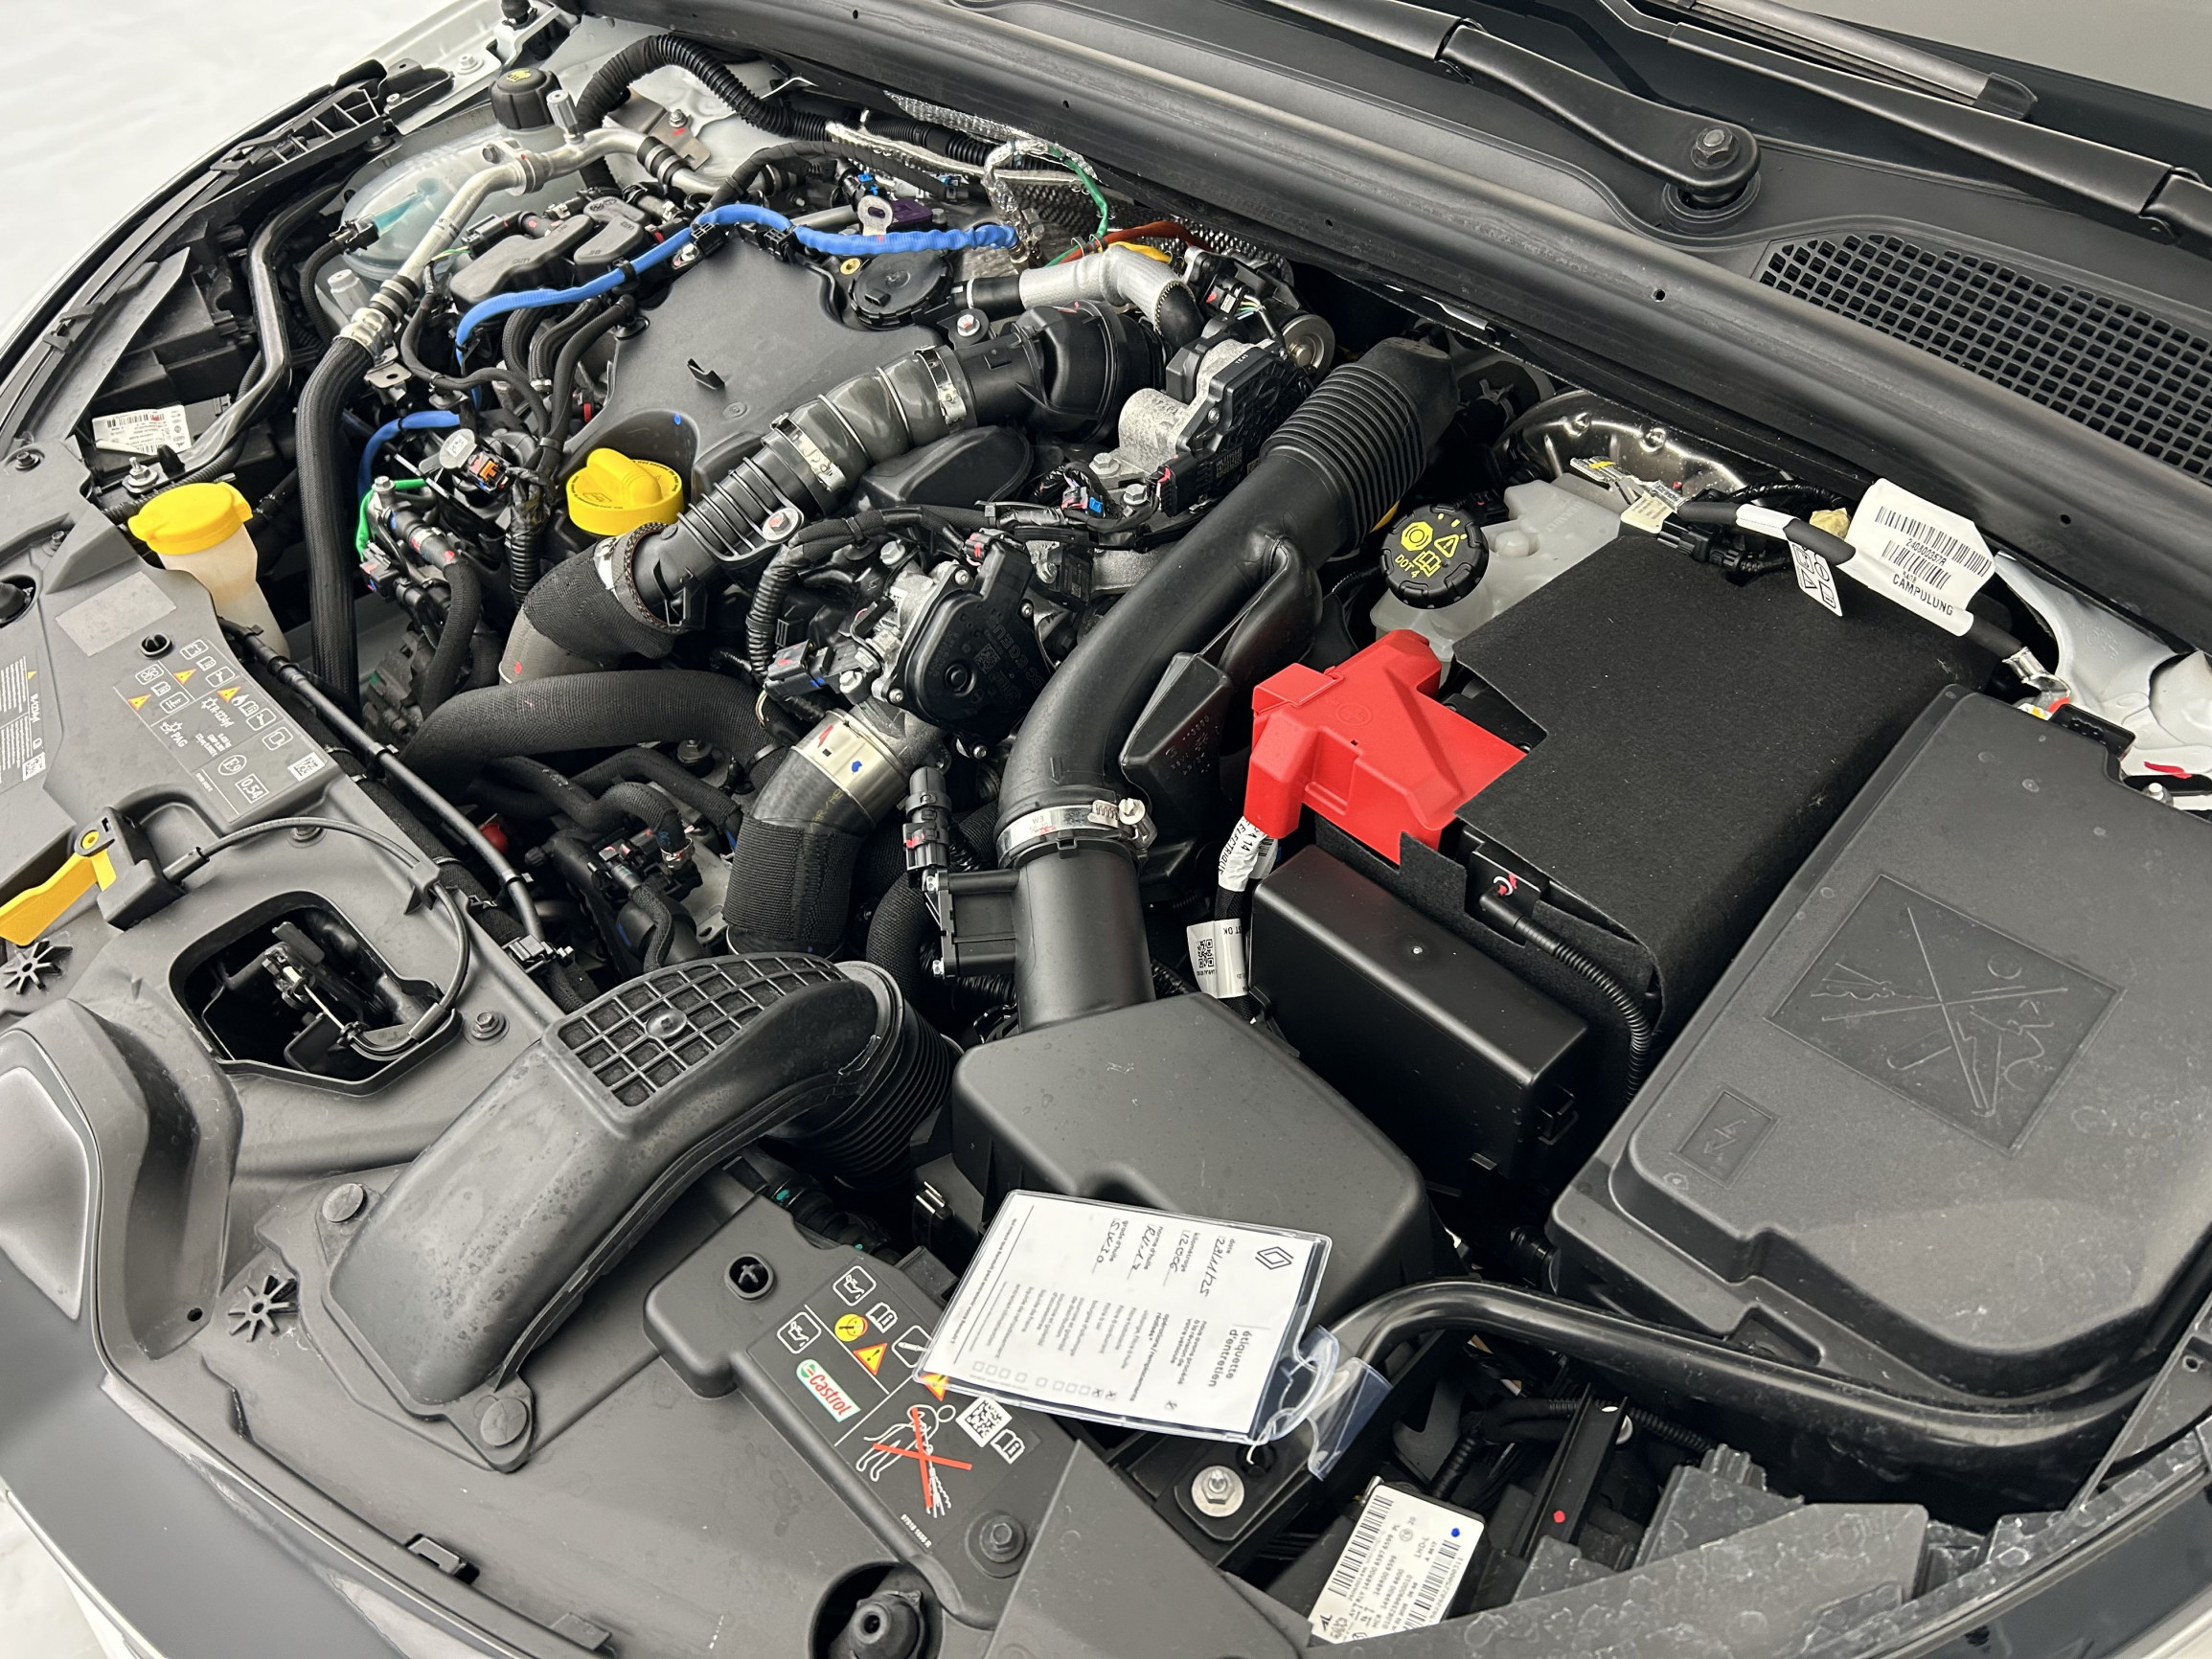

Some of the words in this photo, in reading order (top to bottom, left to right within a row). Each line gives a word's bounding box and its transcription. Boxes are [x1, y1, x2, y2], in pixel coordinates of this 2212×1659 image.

[1395, 554, 1415, 572] DOT
[1410, 569, 1421, 579] 4
[1892, 574, 1955, 616] CAMPULUNG
[171, 731, 187, 747] PAG
[222, 757, 243, 773] E9
[240, 778, 262, 798] 0,54
[1222, 925, 1234, 936] OK
[1118, 1220, 1128, 1239] grade
[1152, 1226, 1163, 1247] norme
[1108, 1239, 1121, 1261] d'huile
[1180, 1232, 1198, 1271] kilométrage
[1225, 1239, 1235, 1253] date
[989, 1250, 1001, 1269] Renault
[1143, 1247, 1155, 1269] d'huile
[983, 1269, 992, 1281] peut
[969, 1281, 985, 1306] entretenir
[1005, 1284, 1020, 1308] entretien
[1020, 1286, 1034, 1305] liquide
[1033, 1289, 1046, 1307] liquide
[962, 1307, 971, 1319] votre
[1083, 1300, 1098, 1323] bougies
[1101, 1302, 1110, 1316] filtre
[1113, 1305, 1124, 1318] filtre
[1127, 1307, 1136, 1321] filtre
[951, 1319, 966, 1339] Renault
[1021, 1315, 1033, 1331] freins
[1056, 1304, 1073, 1337] distribution
[1181, 1318, 1191, 1334] votre
[1197, 1320, 1206, 1335] nous
[994, 1313, 1019, 1358] refroidissement
[1069, 1323, 1086, 1356] d'allumage
[1099, 1324, 1114, 1353] carburant
[1115, 1322, 1129, 1350] habitacle
[1129, 1335, 1139, 1349] filtre
[1181, 1331, 1194, 1357] révision
[1170, 1336, 1183, 1363] véhicule
[1189, 1336, 1199, 1356] avons
[1225, 1330, 1251, 1378] étiquette
[1121, 1354, 1130, 1369] huile
[1176, 1357, 1184, 1366] de
[1208, 1329, 1237, 1386] d'entretien
[1177, 1357, 1192, 1384] procédé
[810, 1374, 852, 1416] Castrol
